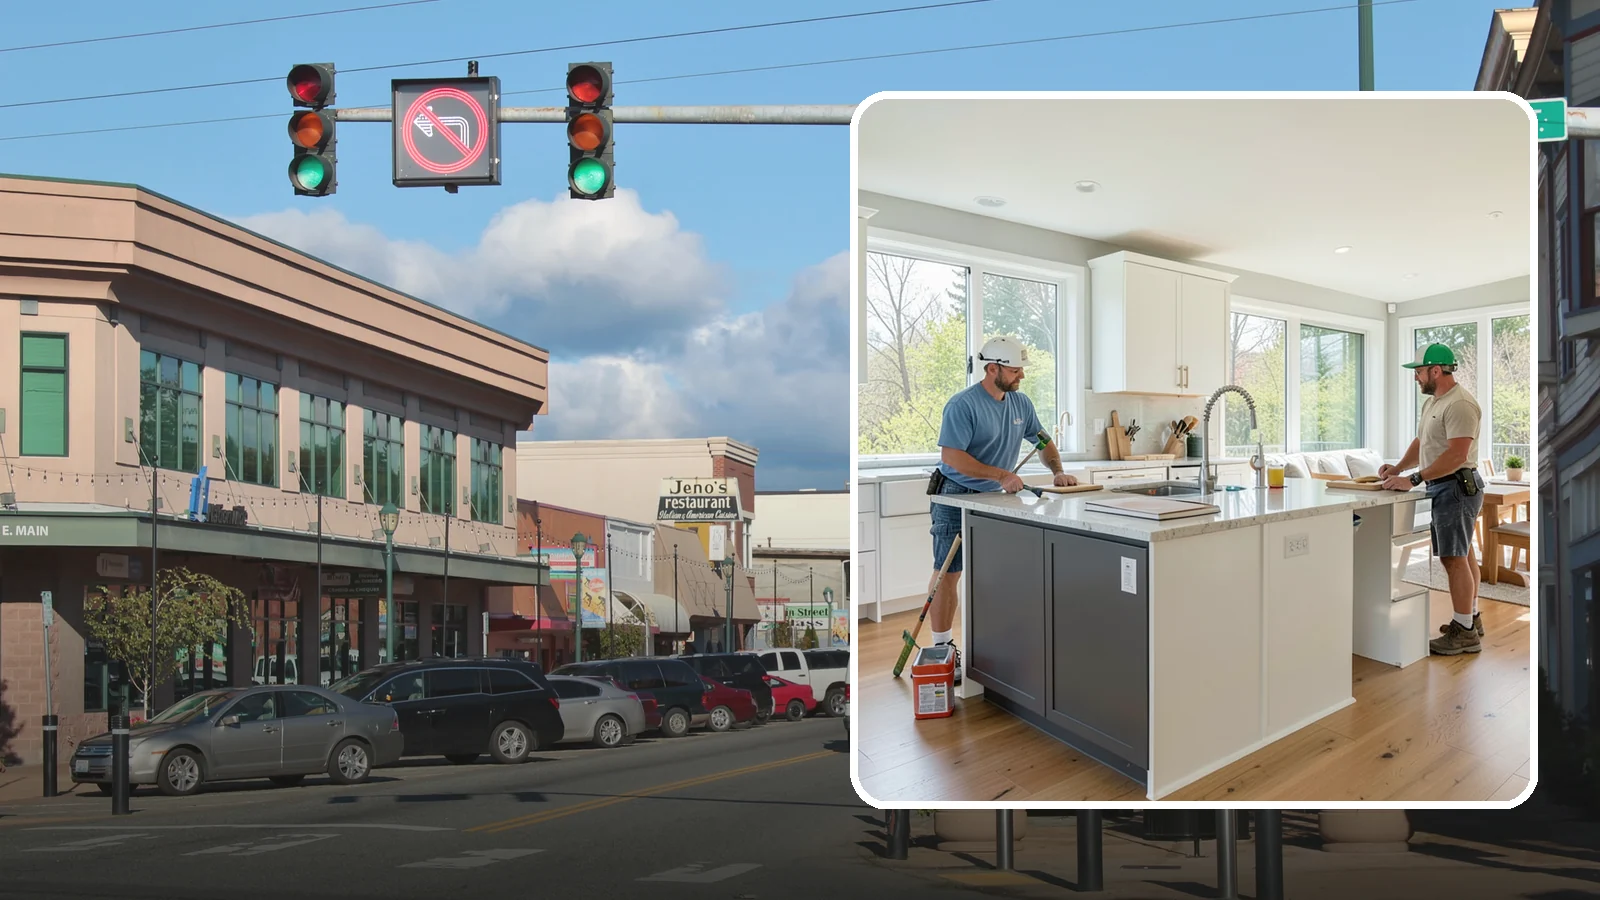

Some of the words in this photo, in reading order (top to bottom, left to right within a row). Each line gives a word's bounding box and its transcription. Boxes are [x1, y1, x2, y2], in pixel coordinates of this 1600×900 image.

[669, 480, 728, 494] Jeno's
[665, 496, 731, 509] restaurant
[659, 510, 682, 519] Italian
[686, 509, 714, 519] American
[715, 509, 737, 519] Cuisine
[2, 525, 13, 536] E.
[15, 525, 49, 536] MAIN
[797, 607, 828, 617] Street
[790, 619, 823, 627] lass
